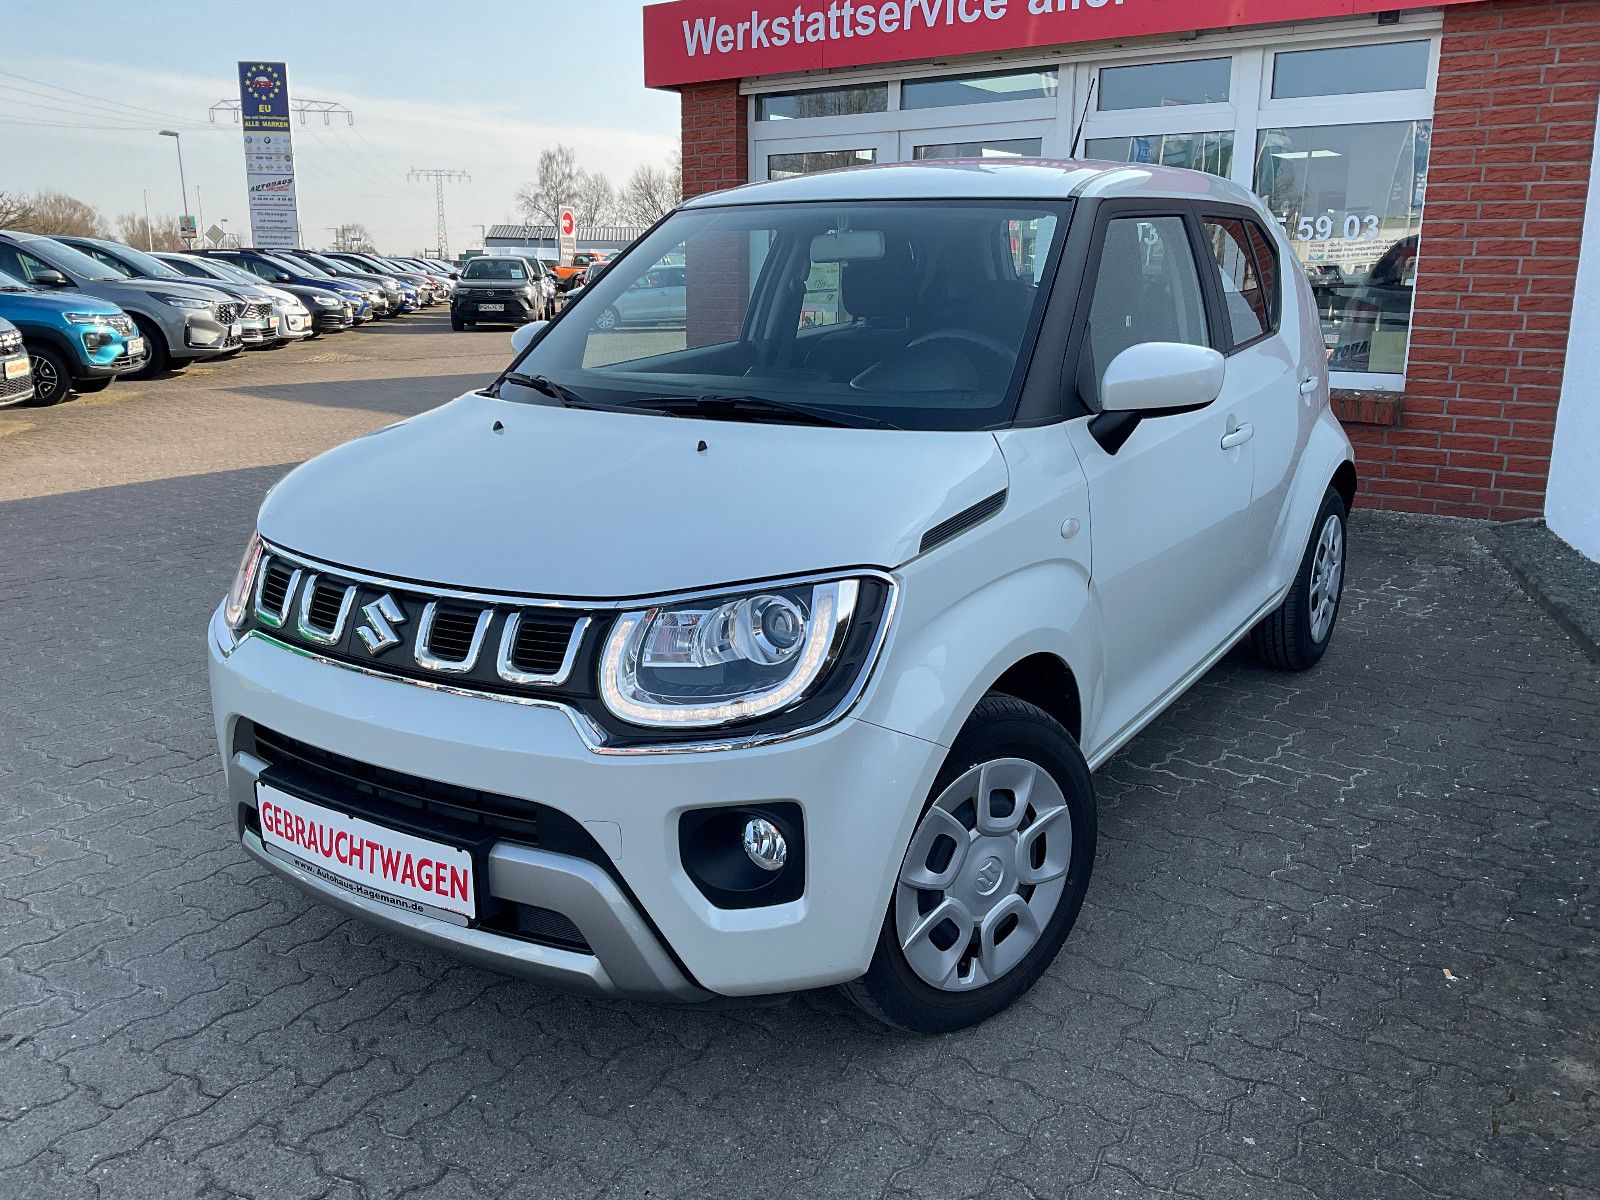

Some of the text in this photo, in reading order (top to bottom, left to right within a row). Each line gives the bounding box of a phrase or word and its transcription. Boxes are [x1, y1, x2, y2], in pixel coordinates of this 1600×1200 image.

[682, 0, 1007, 56] Werkstattservice
[258, 104, 271, 112] EU
[250, 178, 293, 191] AUTOHAUS
[1297, 215, 1332, 241] 59
[1343, 214, 1379, 241] 03
[262, 801, 469, 902] GEBRAUCHTWAGEN
[317, 868, 424, 912] Autohaus-Hagemann.de
